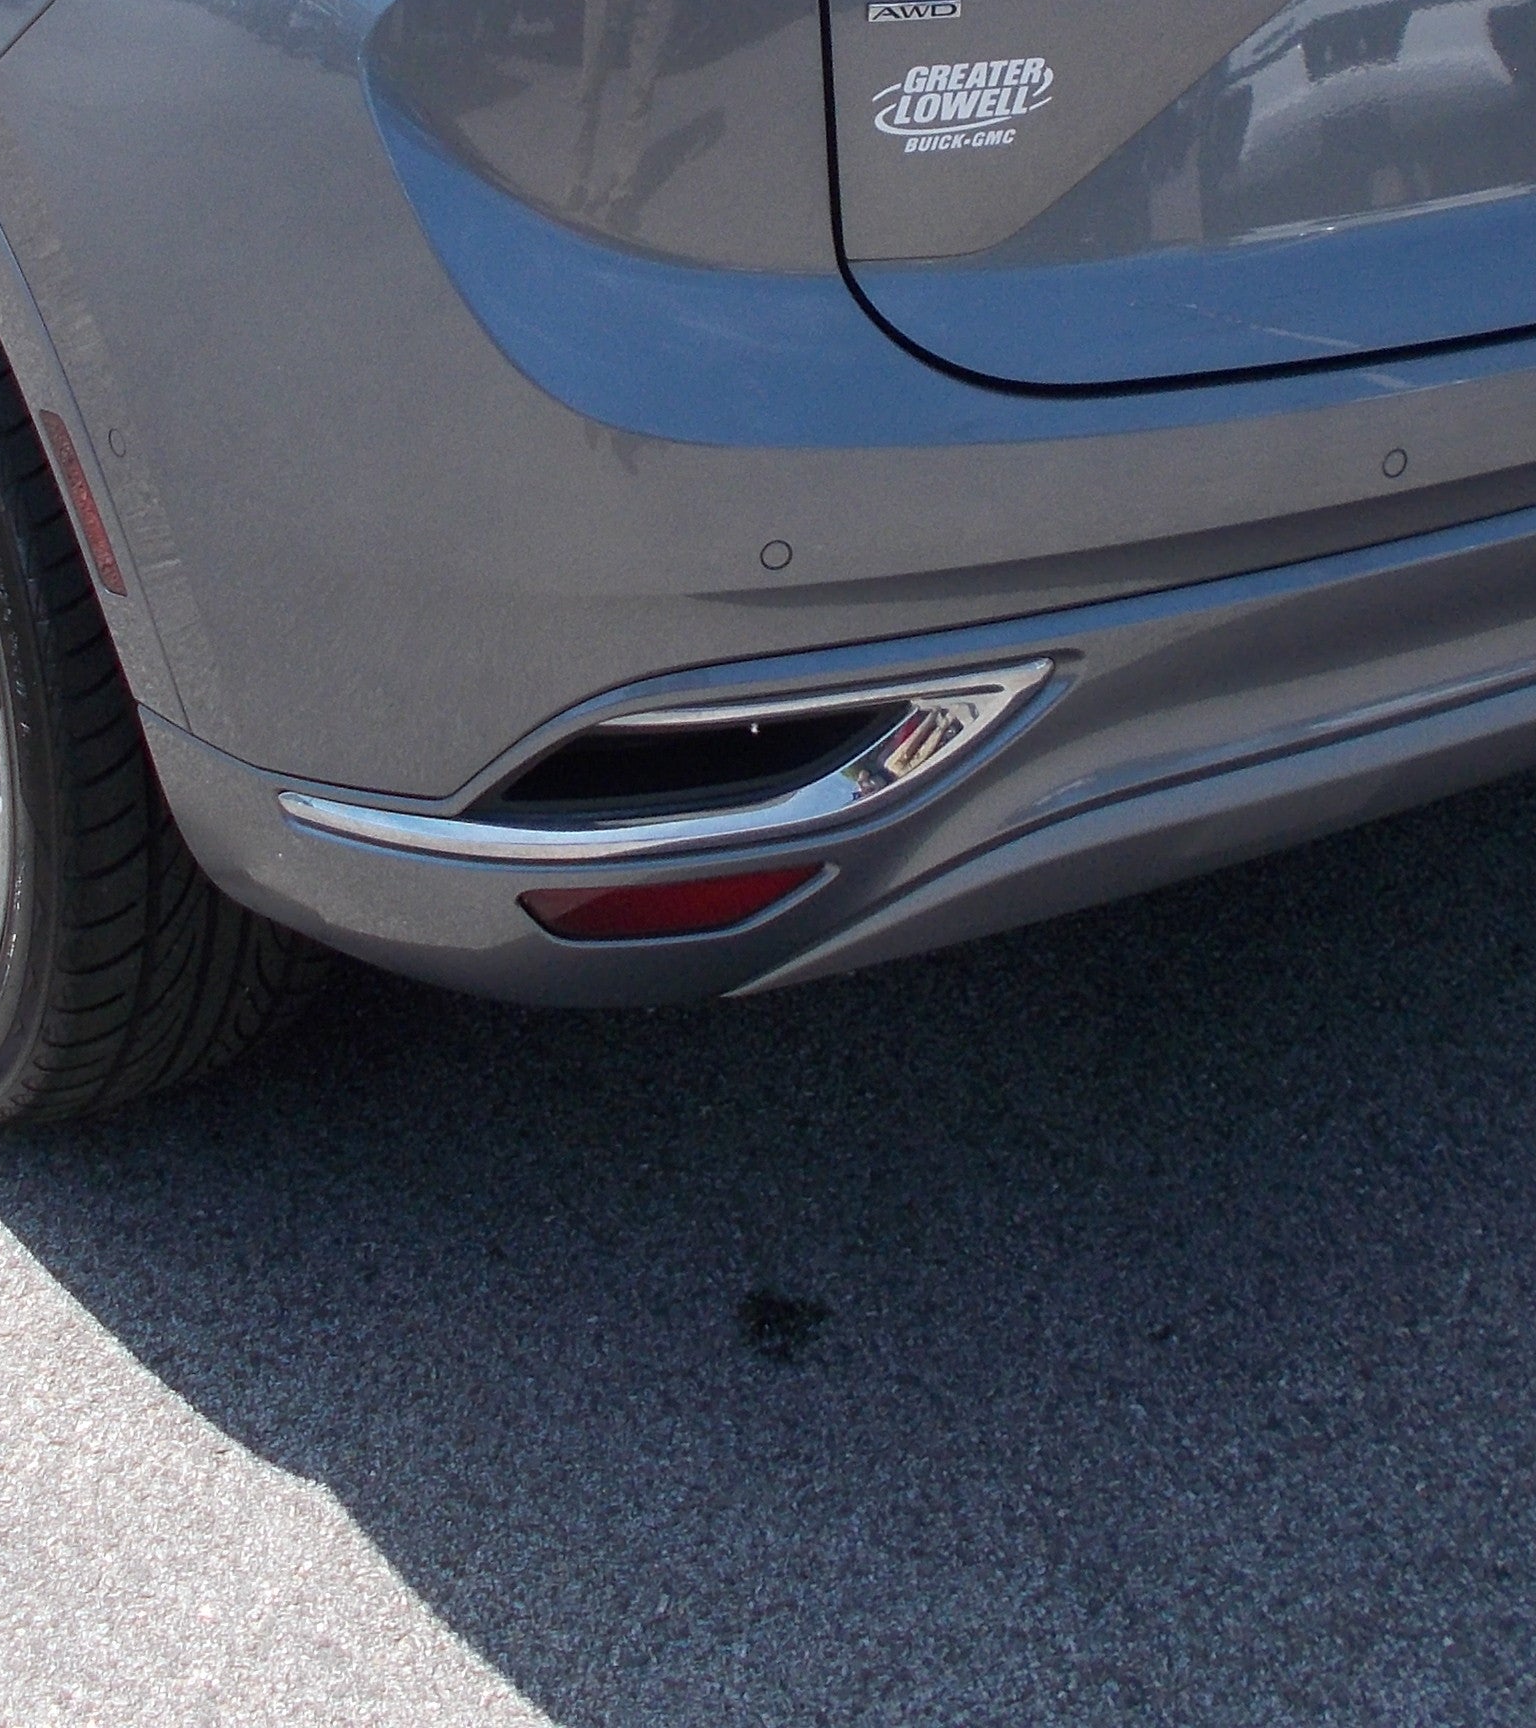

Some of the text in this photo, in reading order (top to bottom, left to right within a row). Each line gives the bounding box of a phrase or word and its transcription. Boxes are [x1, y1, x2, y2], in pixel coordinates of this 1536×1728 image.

[870, 1, 959, 21] AWD
[904, 57, 1046, 93] GREATER
[894, 86, 1030, 126] LOWELL
